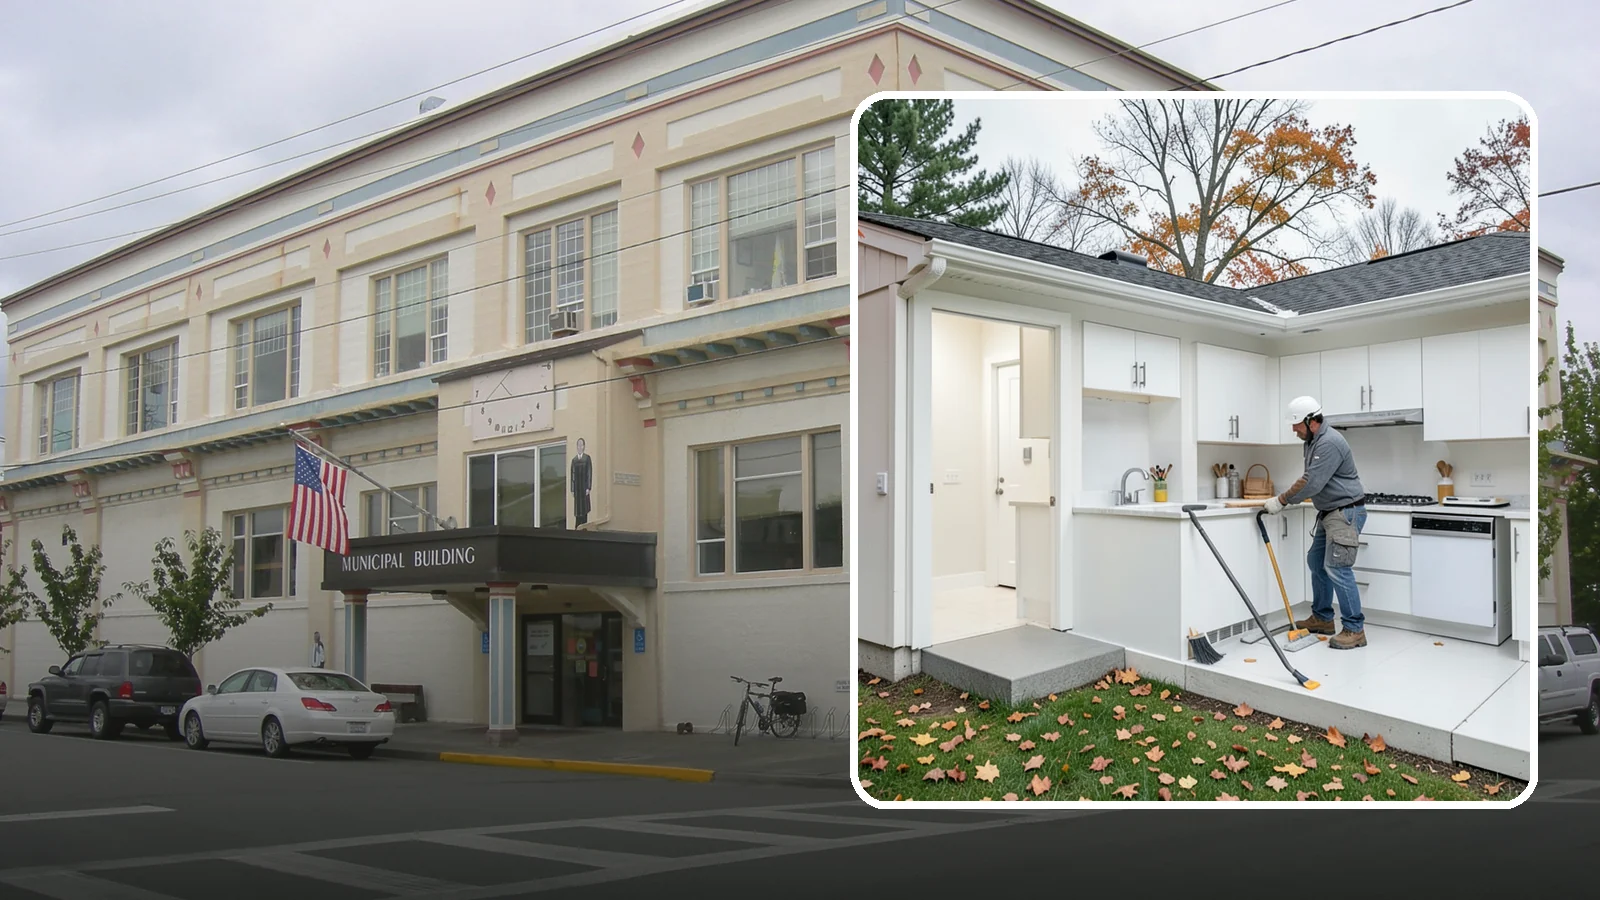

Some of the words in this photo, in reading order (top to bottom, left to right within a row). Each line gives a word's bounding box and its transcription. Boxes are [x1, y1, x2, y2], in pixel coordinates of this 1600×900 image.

[481, 407, 485, 415] 8
[529, 414, 533, 422] 3
[546, 362, 551, 370] 6
[342, 552, 405, 572] MUNICIPAL
[414, 546, 475, 567] BUILDING
